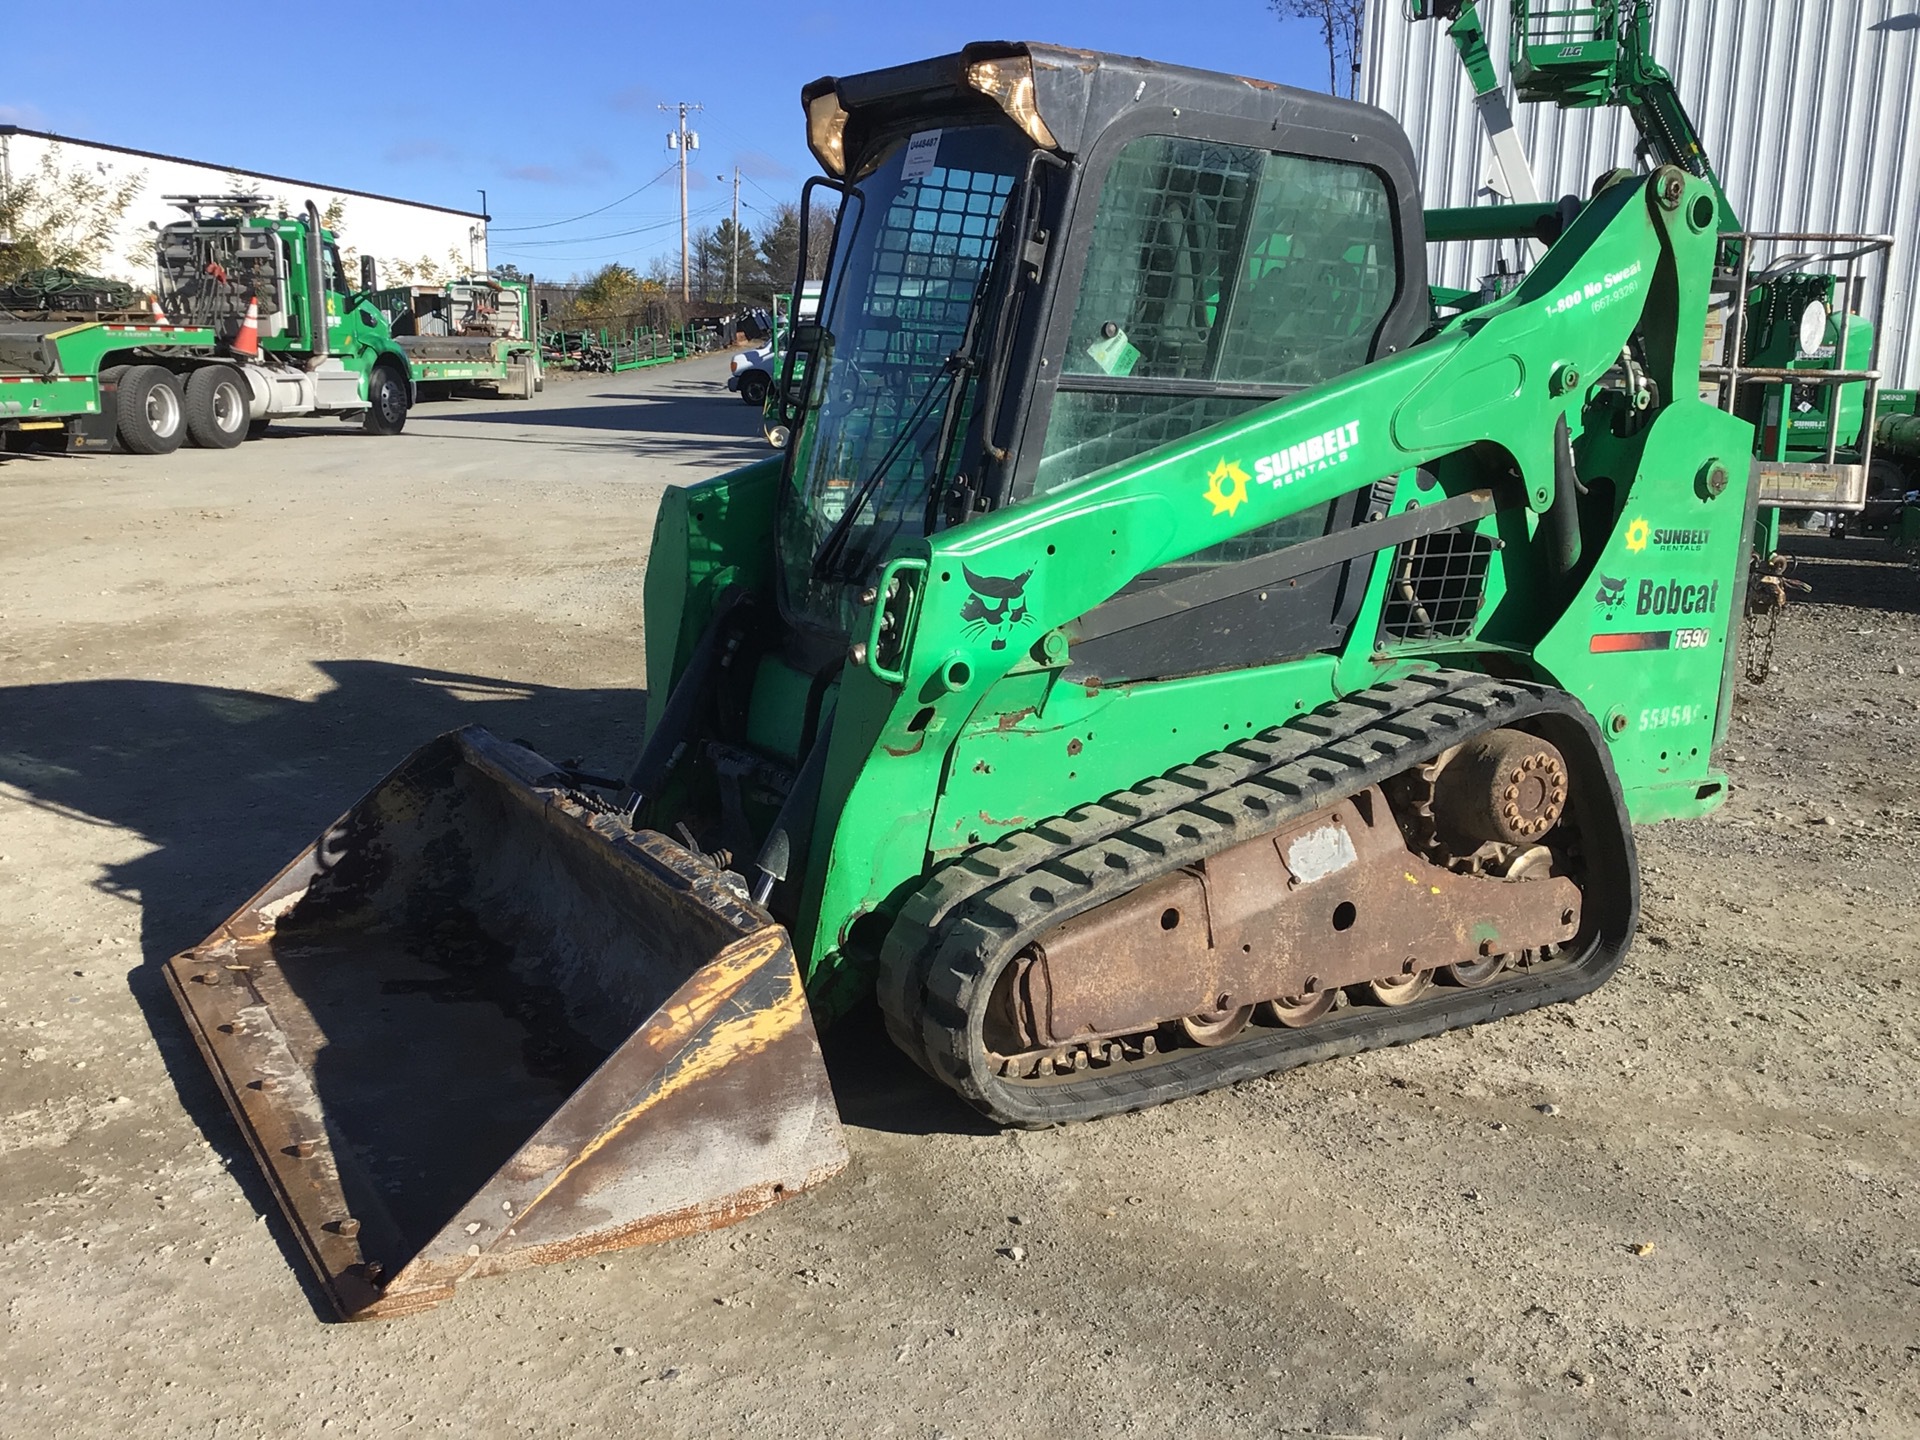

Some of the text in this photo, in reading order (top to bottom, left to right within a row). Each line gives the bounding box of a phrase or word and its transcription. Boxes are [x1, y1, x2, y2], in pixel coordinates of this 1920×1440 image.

[1557, 46, 1584, 58] JLG
[1545, 259, 1642, 318] 1-800 No Sweat
[1591, 280, 1638, 315] (667-9328)
[1254, 420, 1360, 485] SUNBELT
[1272, 451, 1349, 490] RENTALS
[1653, 528, 1711, 545] SUNBELT
[1660, 544, 1702, 552] RENTALS
[1636, 578, 1719, 615] Bobcat
[1675, 628, 1711, 650] T590
